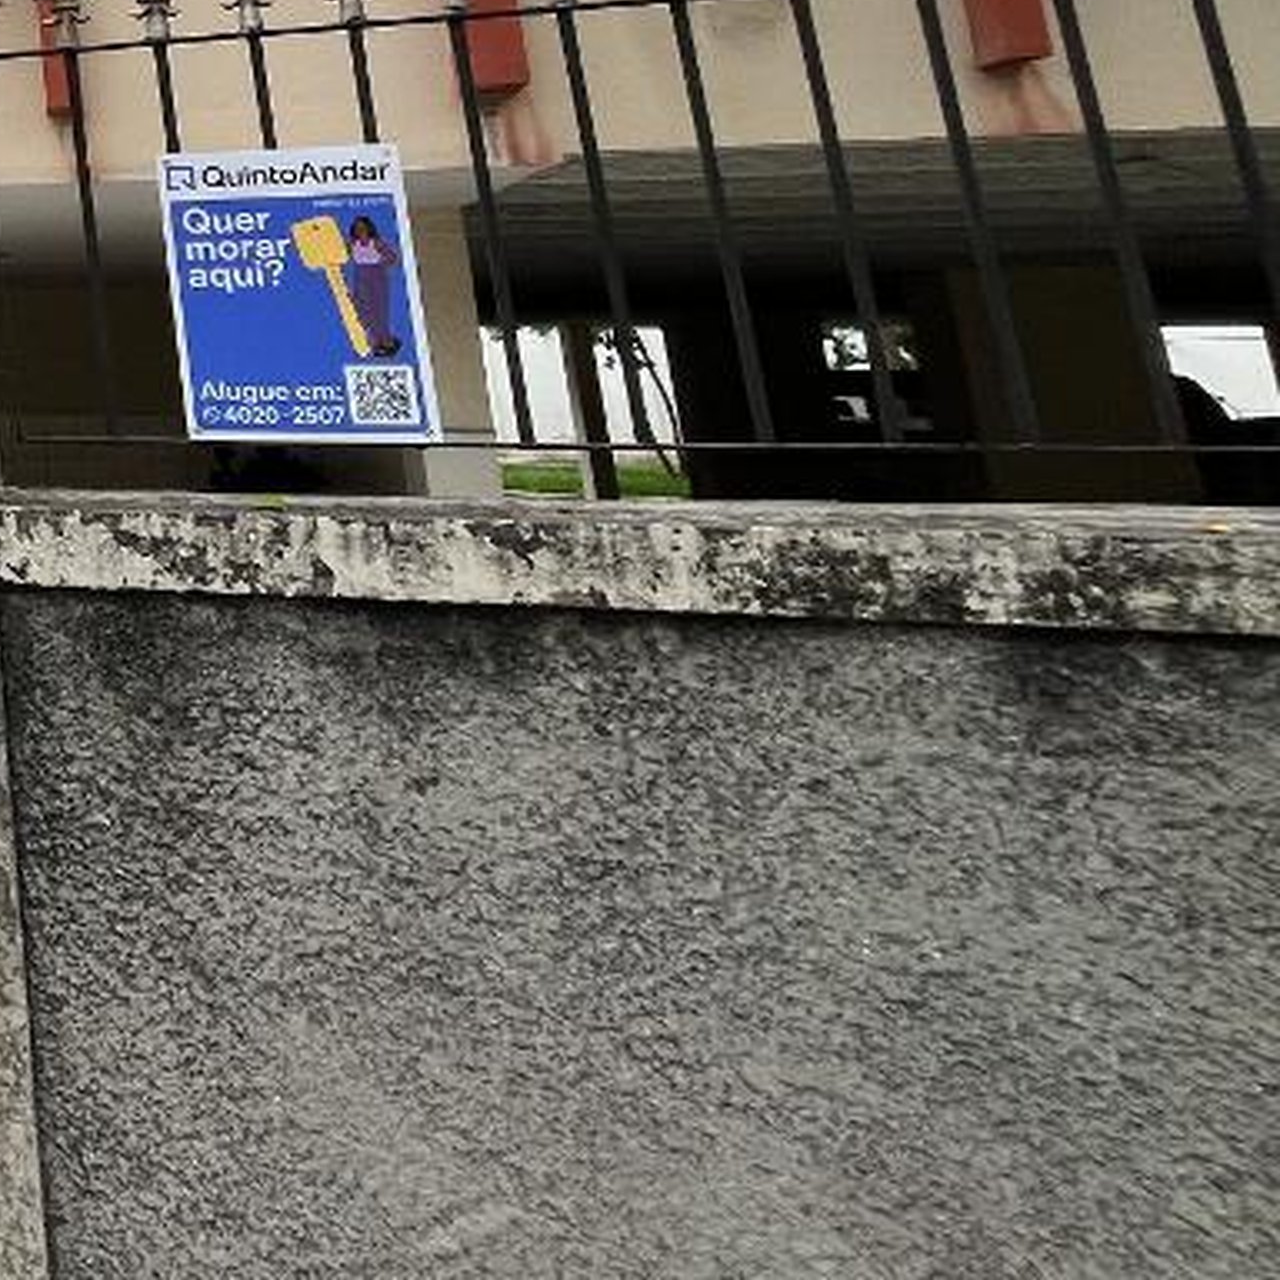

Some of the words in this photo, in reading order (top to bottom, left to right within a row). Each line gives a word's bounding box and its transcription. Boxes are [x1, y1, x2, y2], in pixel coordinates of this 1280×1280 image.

[201, 161, 391, 189] QuintoAndar
[182, 208, 270, 235] Quer
[184, 237, 291, 261] morar
[189, 260, 285, 294] aqui?
[200, 380, 290, 404] Alugue
[295, 385, 345, 402] em:
